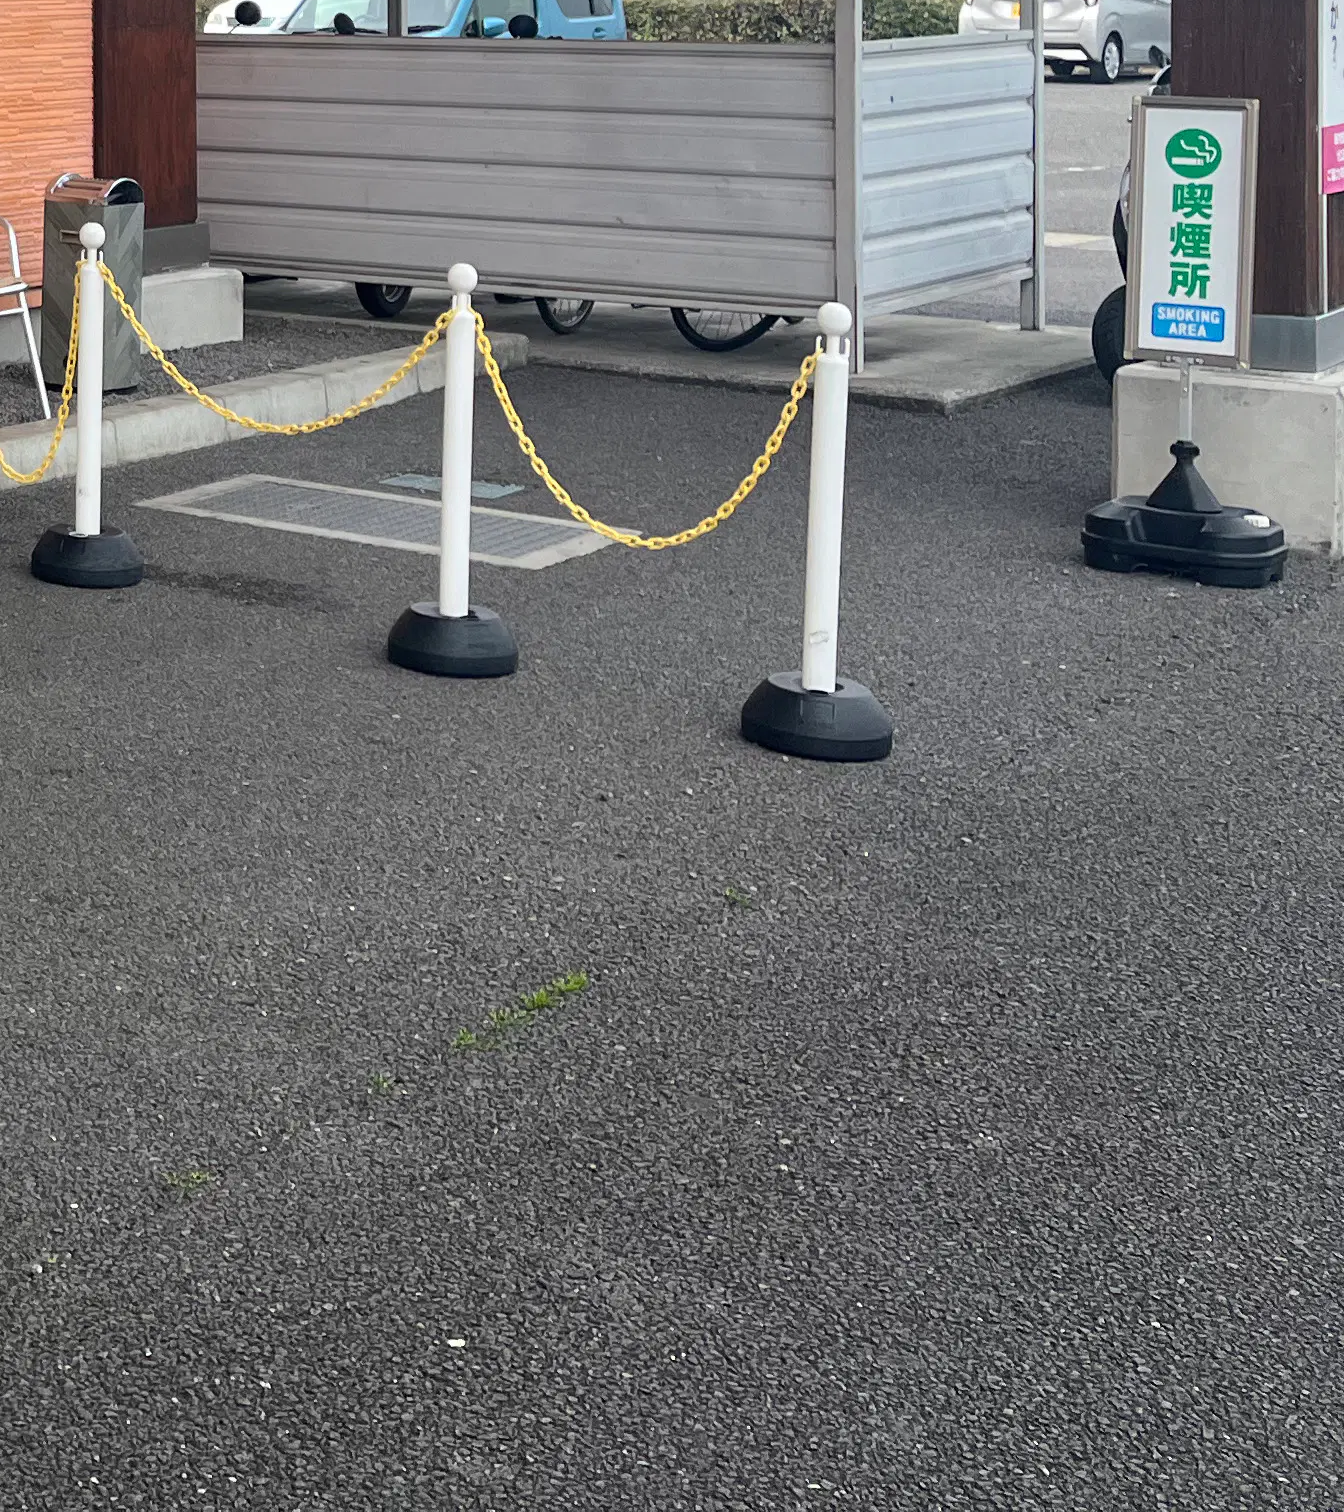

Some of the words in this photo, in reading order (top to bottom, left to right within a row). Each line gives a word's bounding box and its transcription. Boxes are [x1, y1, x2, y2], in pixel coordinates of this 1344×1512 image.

[1168, 182, 1214, 299] 喫煙所
[1157, 305, 1220, 325] SMOKING
[1168, 321, 1207, 338] AREA
